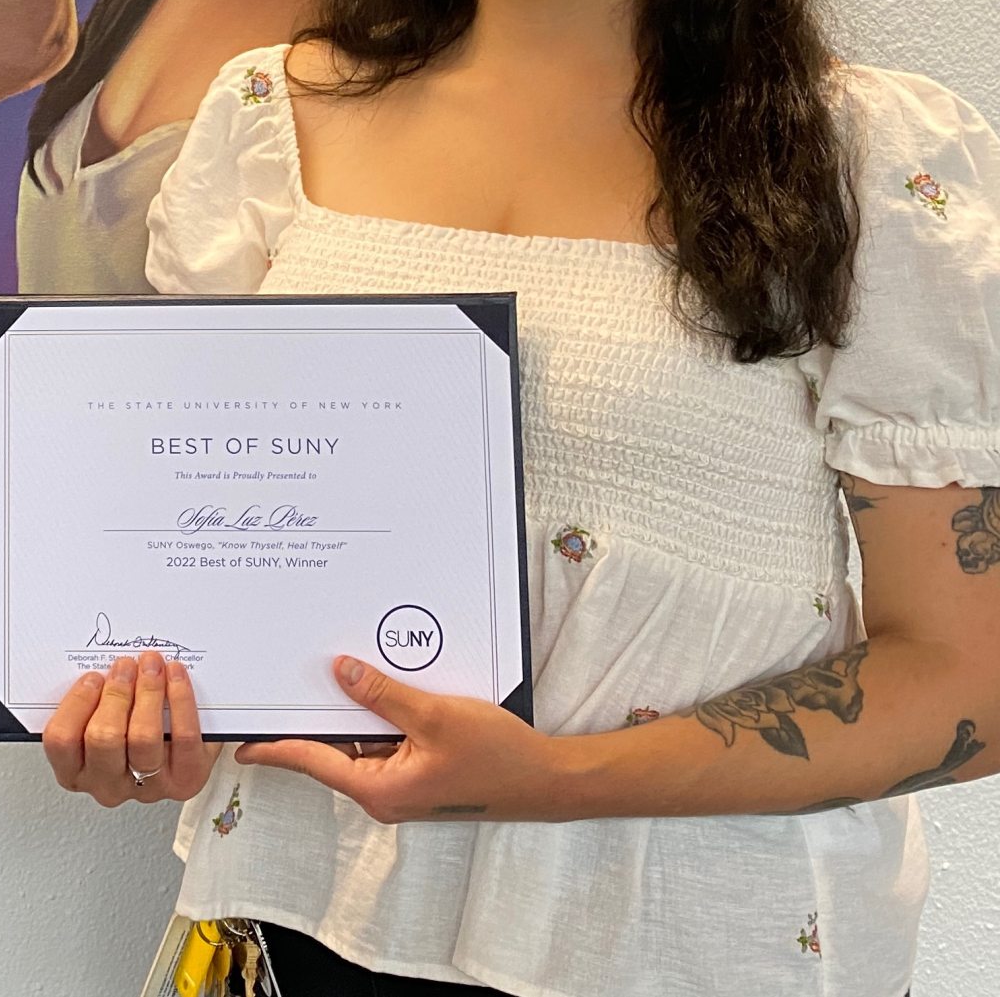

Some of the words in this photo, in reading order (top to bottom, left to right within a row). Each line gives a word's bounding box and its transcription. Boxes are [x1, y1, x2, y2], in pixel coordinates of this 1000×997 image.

[88, 401, 114, 410] THE
[126, 401, 173, 410] STATE
[184, 401, 279, 410] UNIVERSITY
[290, 401, 309, 410] OF
[319, 401, 350, 410] NEW
[362, 401, 403, 410] YORK
[151, 438, 213, 455] BEST
[226, 438, 259, 455] OF
[271, 438, 340, 455] SUNY
[175, 471, 192, 479] This
[195, 471, 221, 479] Award
[223, 471, 230, 479] is
[233, 471, 264, 481] Proudly
[267, 471, 306, 479] Presented
[308, 471, 317, 479] to
[224, 504, 263, 531] Luz
[147, 541, 172, 549] SUNY
[176, 541, 215, 551] Oswego,
[250, 541, 284, 551] Thyself,
[287, 541, 307, 549] Heal
[166, 557, 196, 567] 2022
[200, 557, 226, 567] Best
[230, 557, 242, 567] of
[245, 557, 281, 569] SUNY,
[285, 557, 329, 567] Winner
[385, 630, 434, 647] SUNY
